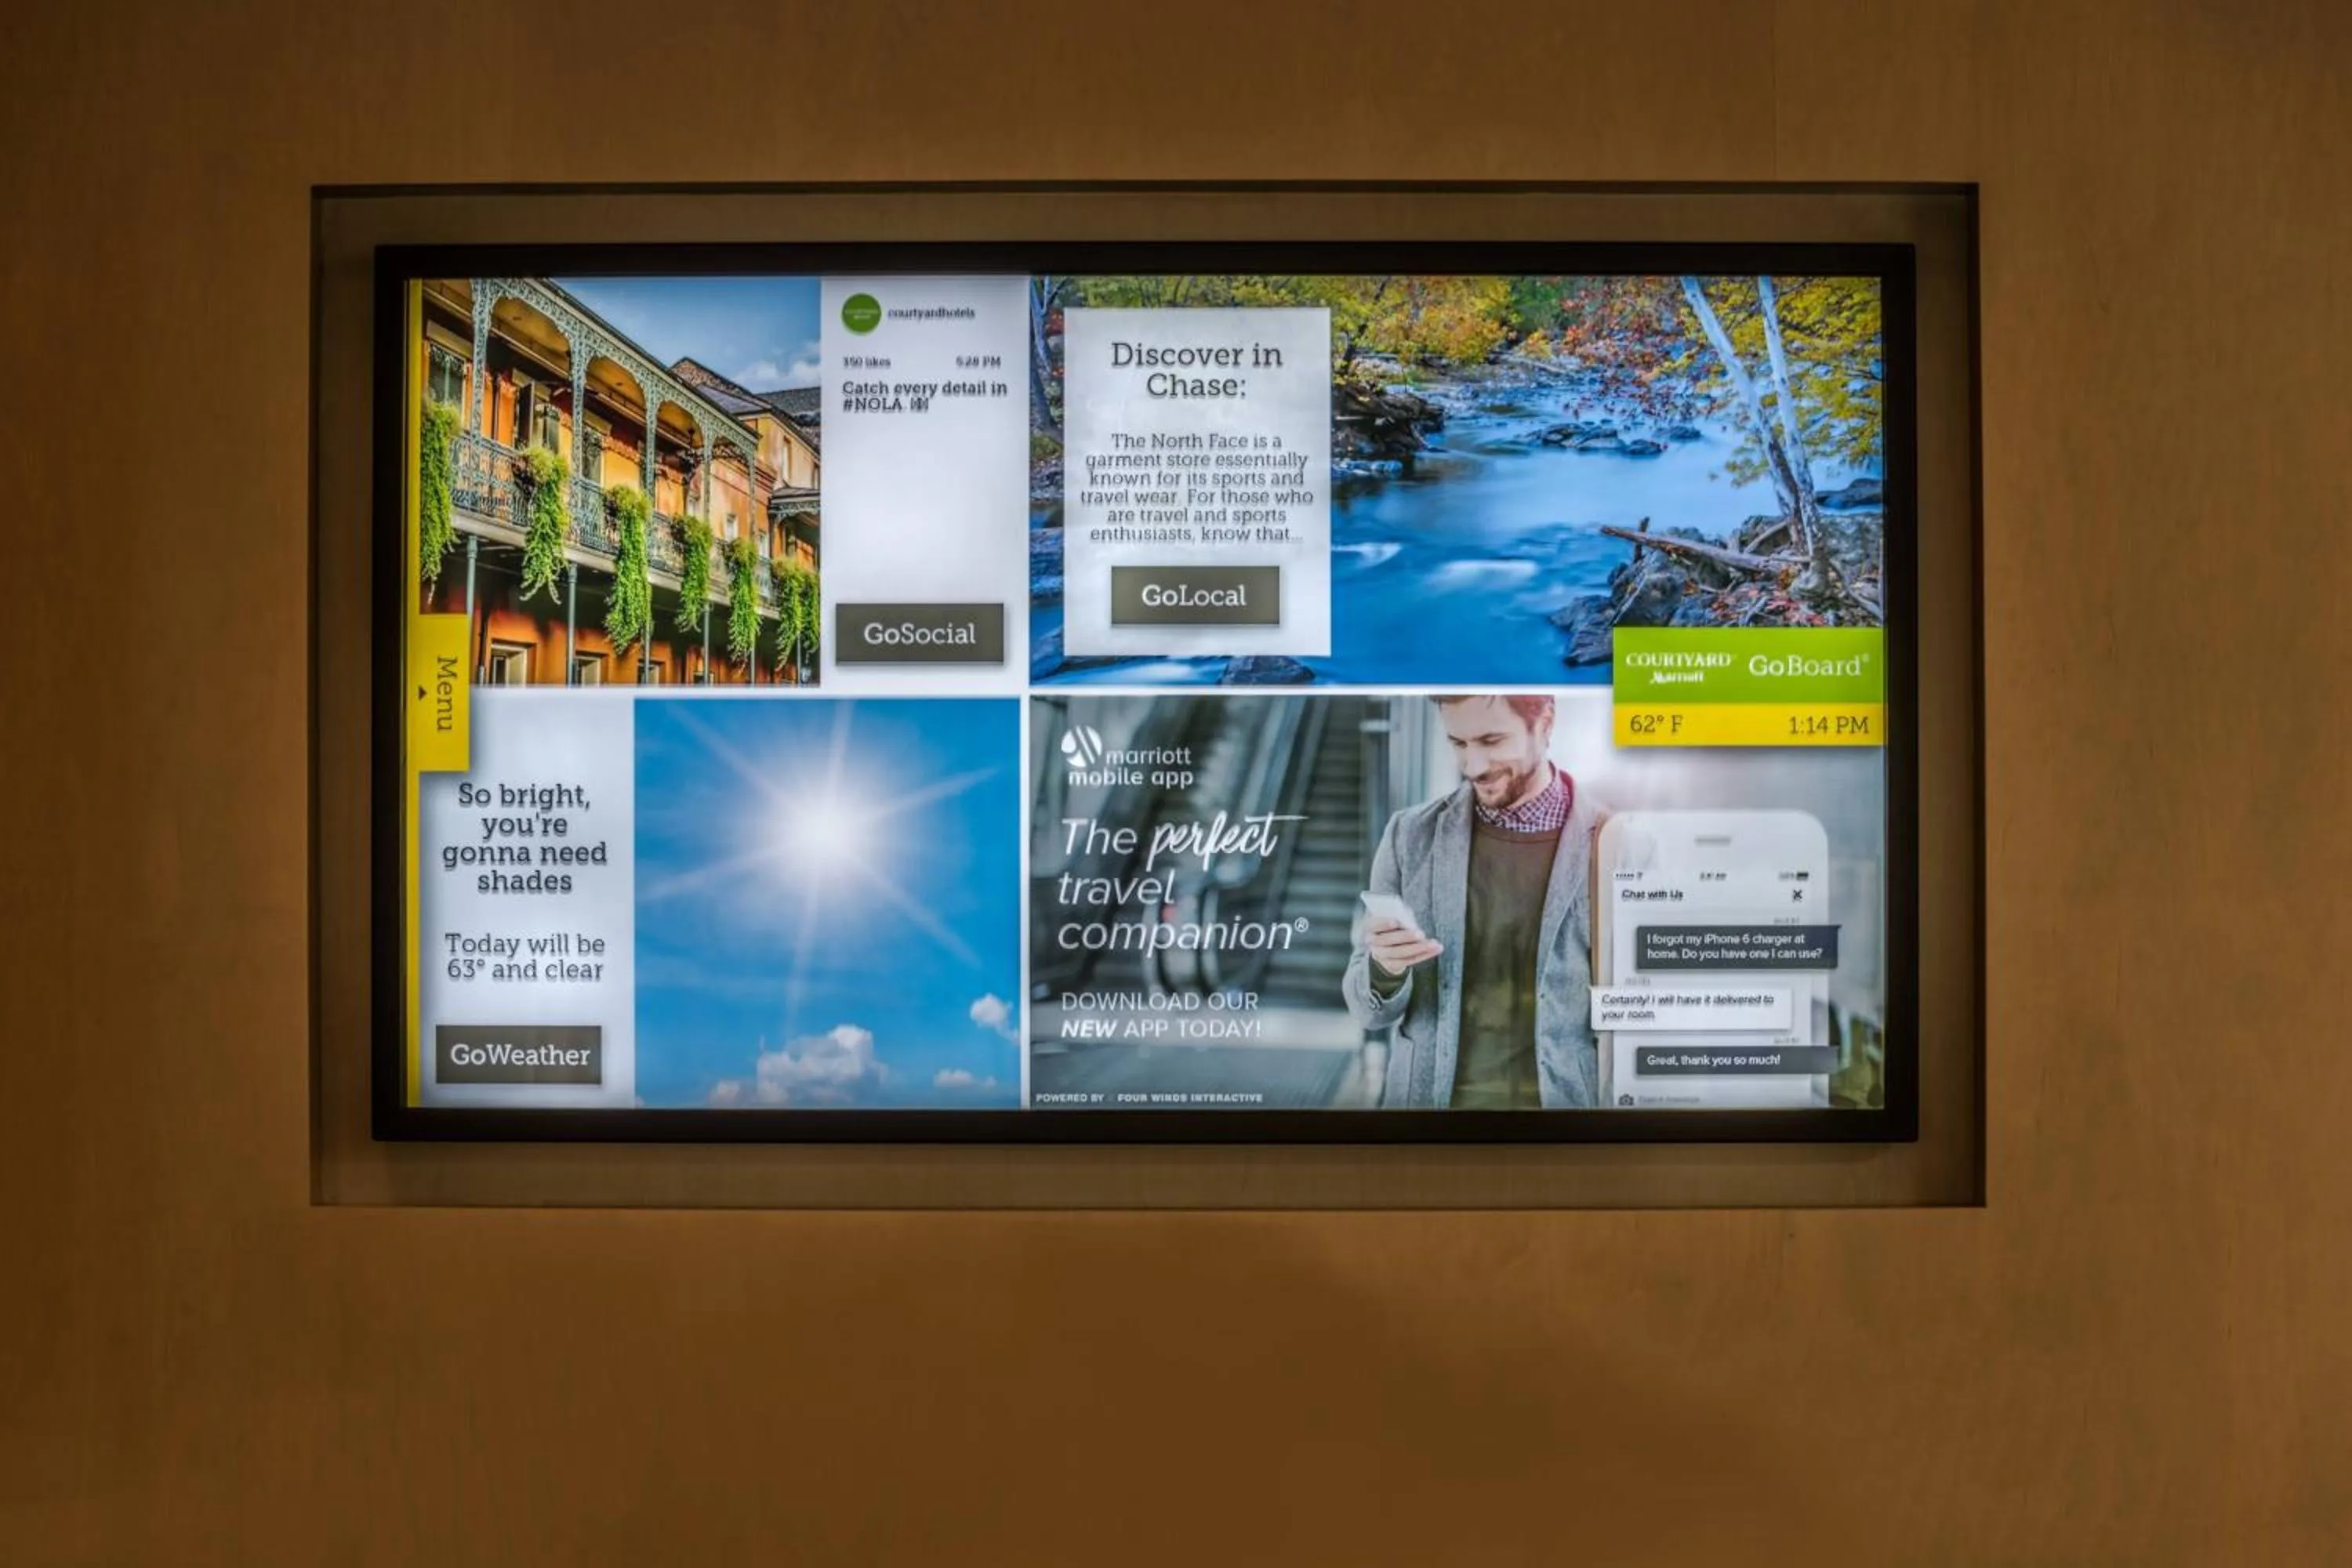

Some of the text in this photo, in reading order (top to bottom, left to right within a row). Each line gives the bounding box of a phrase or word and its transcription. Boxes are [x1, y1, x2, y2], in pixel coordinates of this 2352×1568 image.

[982, 356, 1001, 367] PM
[1112, 343, 1283, 368] Discover in
[843, 381, 1007, 397] Catch every detail in
[1146, 373, 1247, 398] Chase:
[1112, 434, 1283, 448] The North Face is a
[1086, 452, 1308, 470] garment store essentially
[1090, 472, 1305, 488] known for its sports and
[1081, 489, 1129, 505] travel
[1188, 489, 1216, 505] For
[1221, 489, 1270, 505] those
[1275, 489, 1314, 505] who
[1108, 507, 1287, 525] are travel and sports
[1091, 526, 1196, 543] enthusiasts,
[1201, 526, 1250, 541] know
[1142, 585, 1247, 608] GoLocal
[864, 622, 977, 645] GoSocial
[1625, 652, 1733, 668] COURTYARD
[436, 656, 458, 733] Menu
[1630, 715, 1684, 735] 62° F
[1790, 716, 1871, 735] 1:14 PM
[1105, 747, 1192, 765] marriott
[1069, 767, 1194, 789] mobile app
[458, 782, 591, 812] So bright,
[481, 811, 568, 841] you're
[1061, 810, 1311, 873] The perfect
[442, 841, 608, 869] gonna need
[477, 869, 573, 894] shades
[1058, 870, 1175, 905] travel
[1621, 889, 1683, 900] Chat with Us
[445, 932, 606, 960] Today will be
[1652, 934, 1684, 946] forgot
[1686, 936, 1702, 946] my
[1704, 934, 1740, 944] iPhone
[1742, 935, 1750, 944] 6
[1752, 935, 1793, 946] charger
[1795, 935, 1806, 944] at
[1647, 949, 1679, 959] home.
[1682, 949, 1697, 959] Do
[1699, 951, 1719, 961] you
[1722, 949, 1748, 959] have
[1798, 949, 1823, 959] use?
[448, 959, 603, 981] 63° and clear
[1062, 993, 1258, 1011] DOWNLOAD OUR
[1658, 995, 1675, 1004] will
[1677, 994, 1702, 1005] have
[1704, 995, 1711, 1004] it
[1713, 994, 1762, 1005] delivered
[1763, 996, 1774, 1004] to
[1602, 1010, 1625, 1021] your
[1062, 1020, 1261, 1038] NEW APP TODAY!
[451, 1044, 590, 1065] GoWeather
[1647, 1055, 1679, 1065] Great,
[1681, 1055, 1710, 1065] thank
[1712, 1058, 1731, 1067] you
[1748, 1055, 1780, 1065] much!
[1036, 1094, 1087, 1102] POWERED
[1091, 1094, 1104, 1102] BY
[1117, 1094, 1147, 1102] FOUR
[1191, 1094, 1263, 1102] INTERACTIVE
